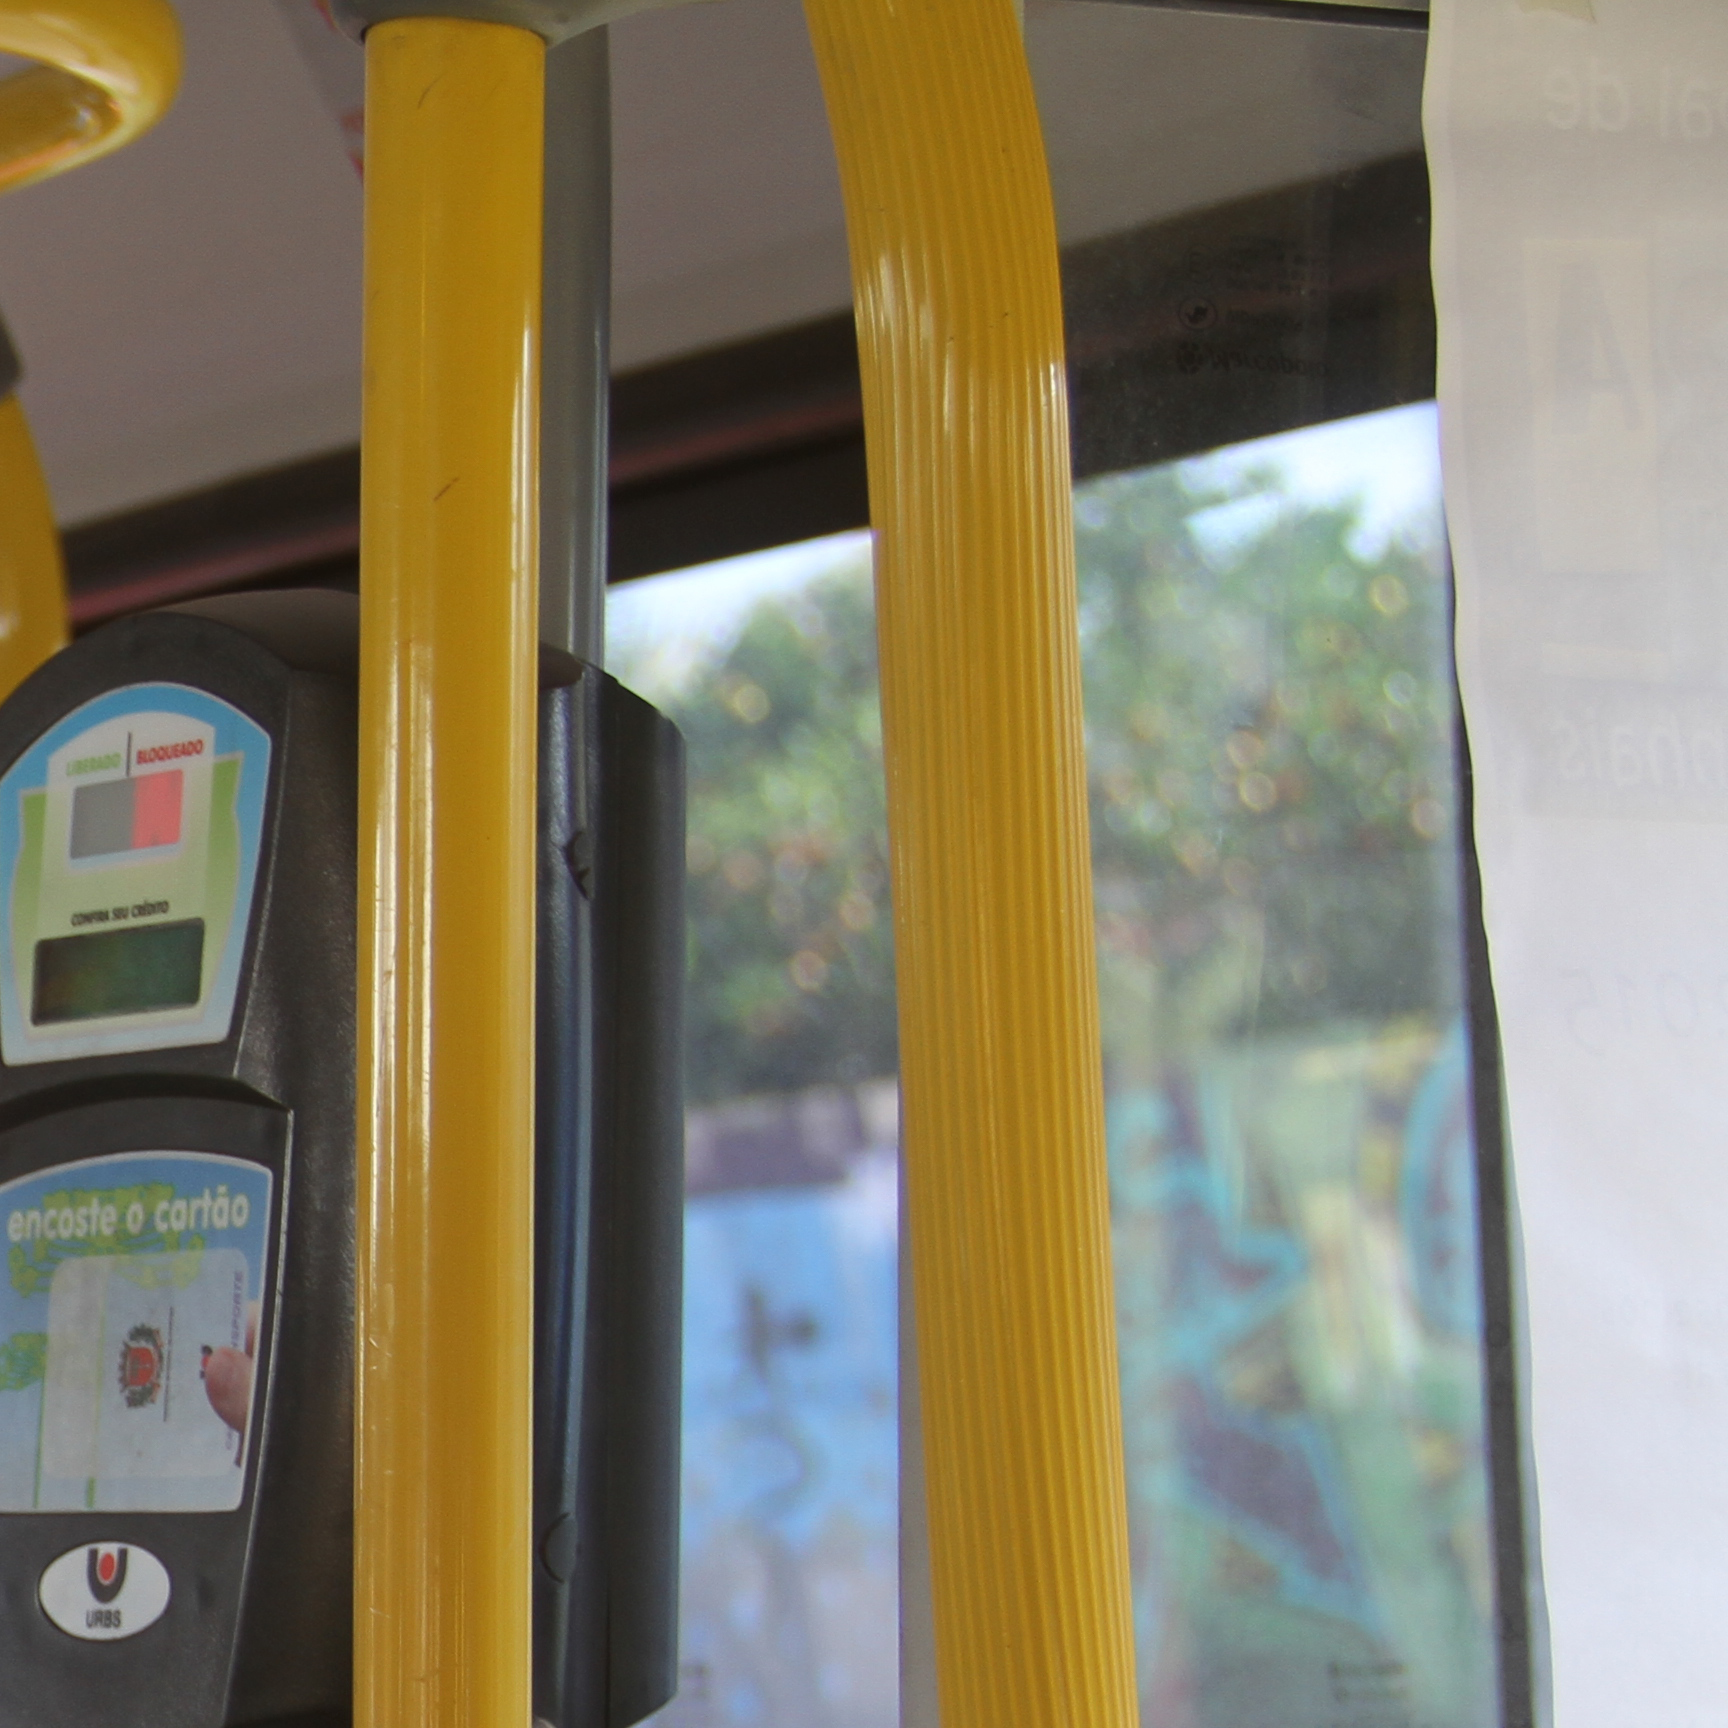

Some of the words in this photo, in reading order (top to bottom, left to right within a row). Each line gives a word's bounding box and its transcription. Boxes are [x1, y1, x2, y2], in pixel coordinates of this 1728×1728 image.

[66, 751, 122, 777] LIBERADO
[135, 738, 204, 765] BLOQUEADO
[7, 1197, 119, 1243] encoste
[126, 1201, 144, 1235] o
[154, 1184, 250, 1233] cartão
[85, 1609, 122, 1629] URBS
